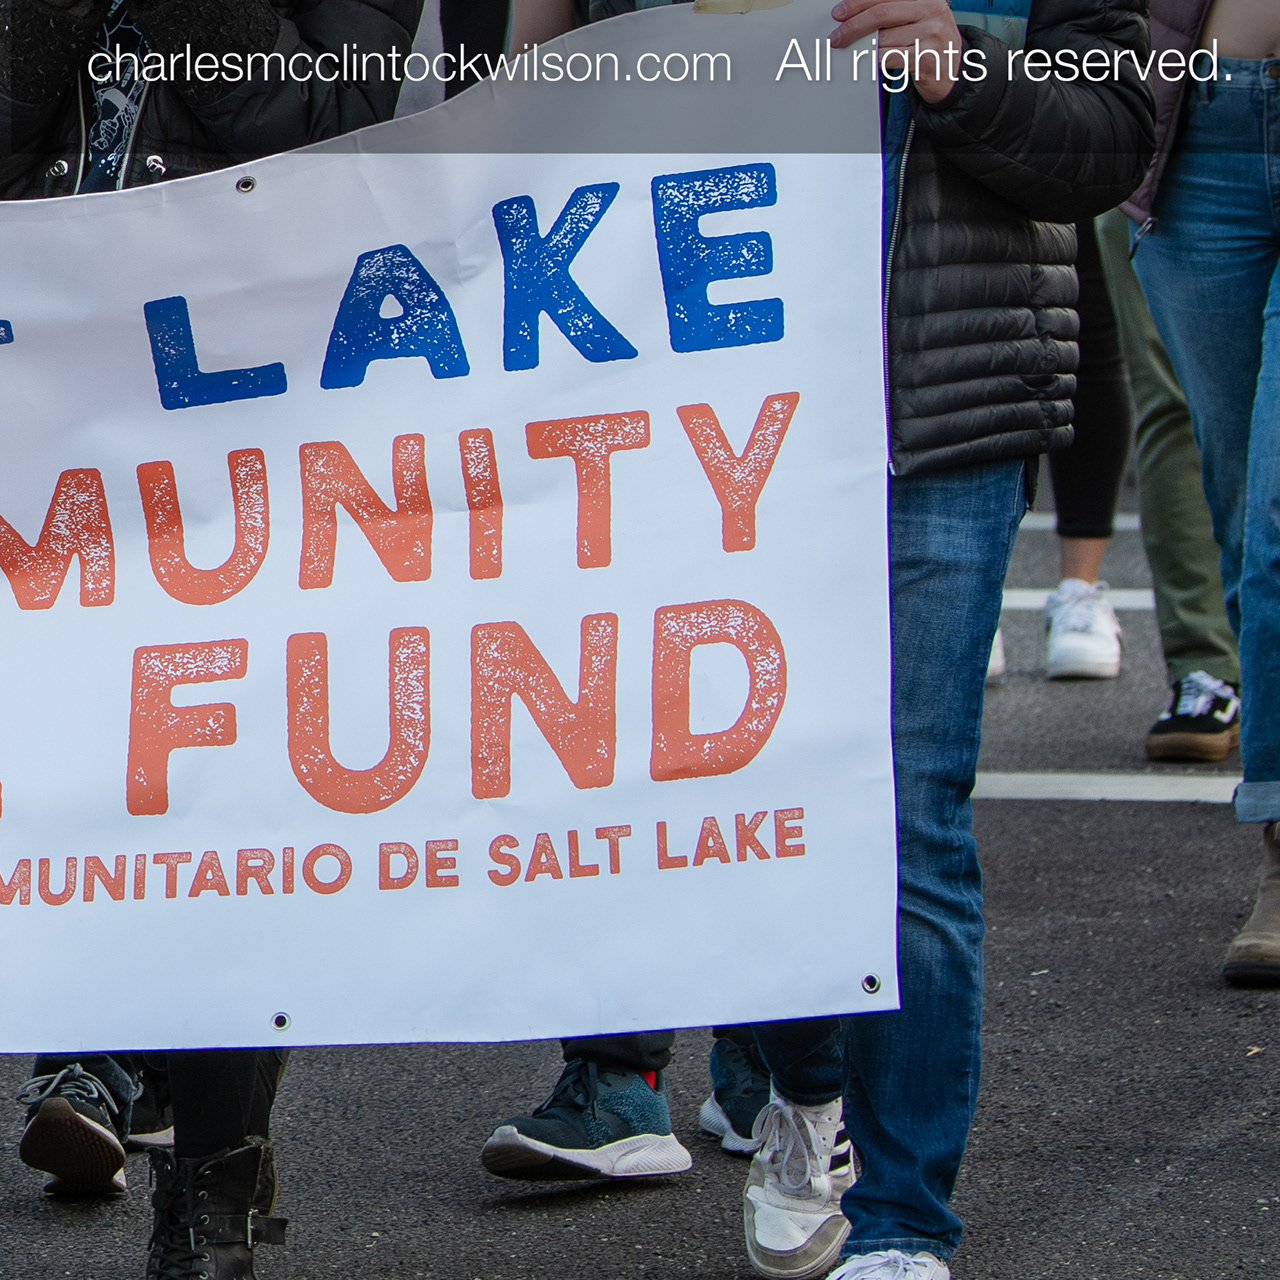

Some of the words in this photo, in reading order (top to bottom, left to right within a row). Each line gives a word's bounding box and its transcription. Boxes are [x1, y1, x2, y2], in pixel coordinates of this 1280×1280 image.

[143, 161, 786, 410] LAKE
[126, 598, 788, 817] FUND
[378, 839, 460, 891] DE
[486, 824, 633, 887] SALT
[655, 807, 806, 870] LAKE
